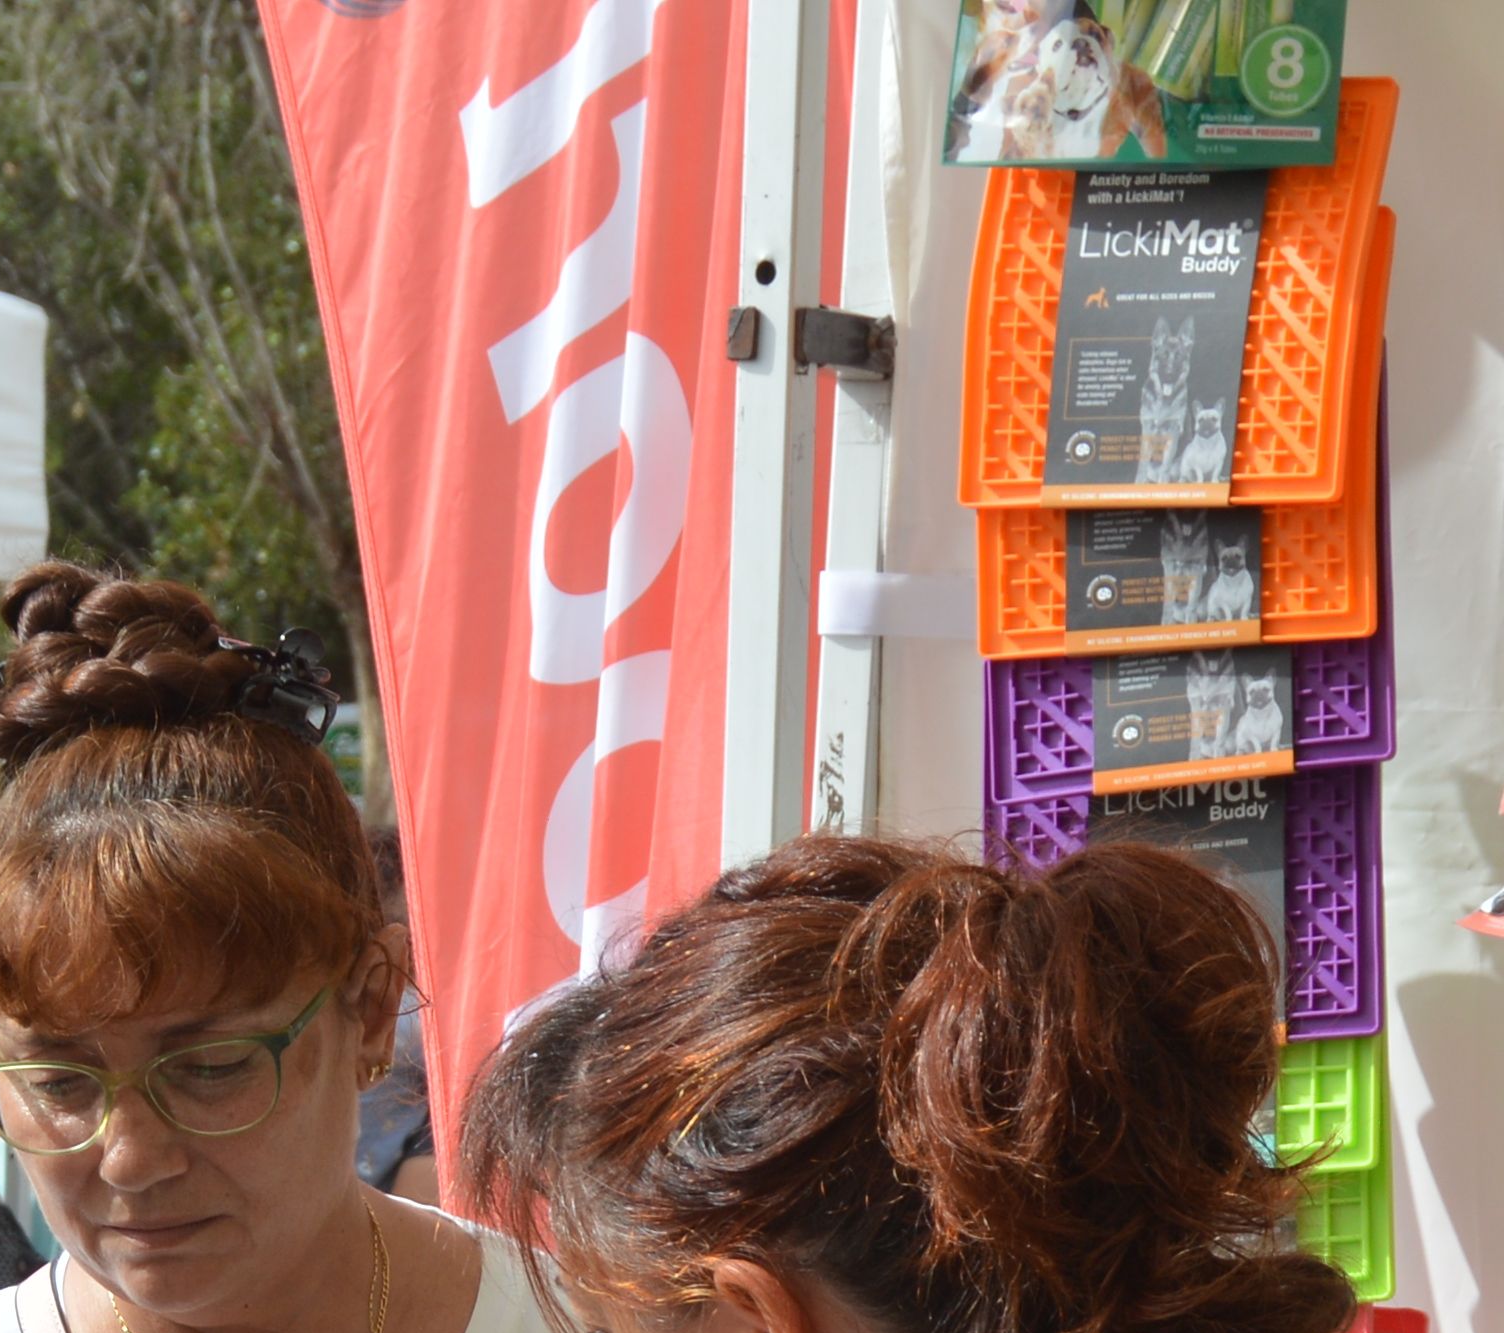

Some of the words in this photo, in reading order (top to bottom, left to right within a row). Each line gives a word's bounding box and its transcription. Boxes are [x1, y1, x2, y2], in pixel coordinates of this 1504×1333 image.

[1267, 38, 1305, 89] 8
[1089, 173, 1132, 189] Anxiety
[1134, 173, 1157, 187] and
[1158, 172, 1210, 186] Boredom
[1208, 802, 1269, 823] Buddy
